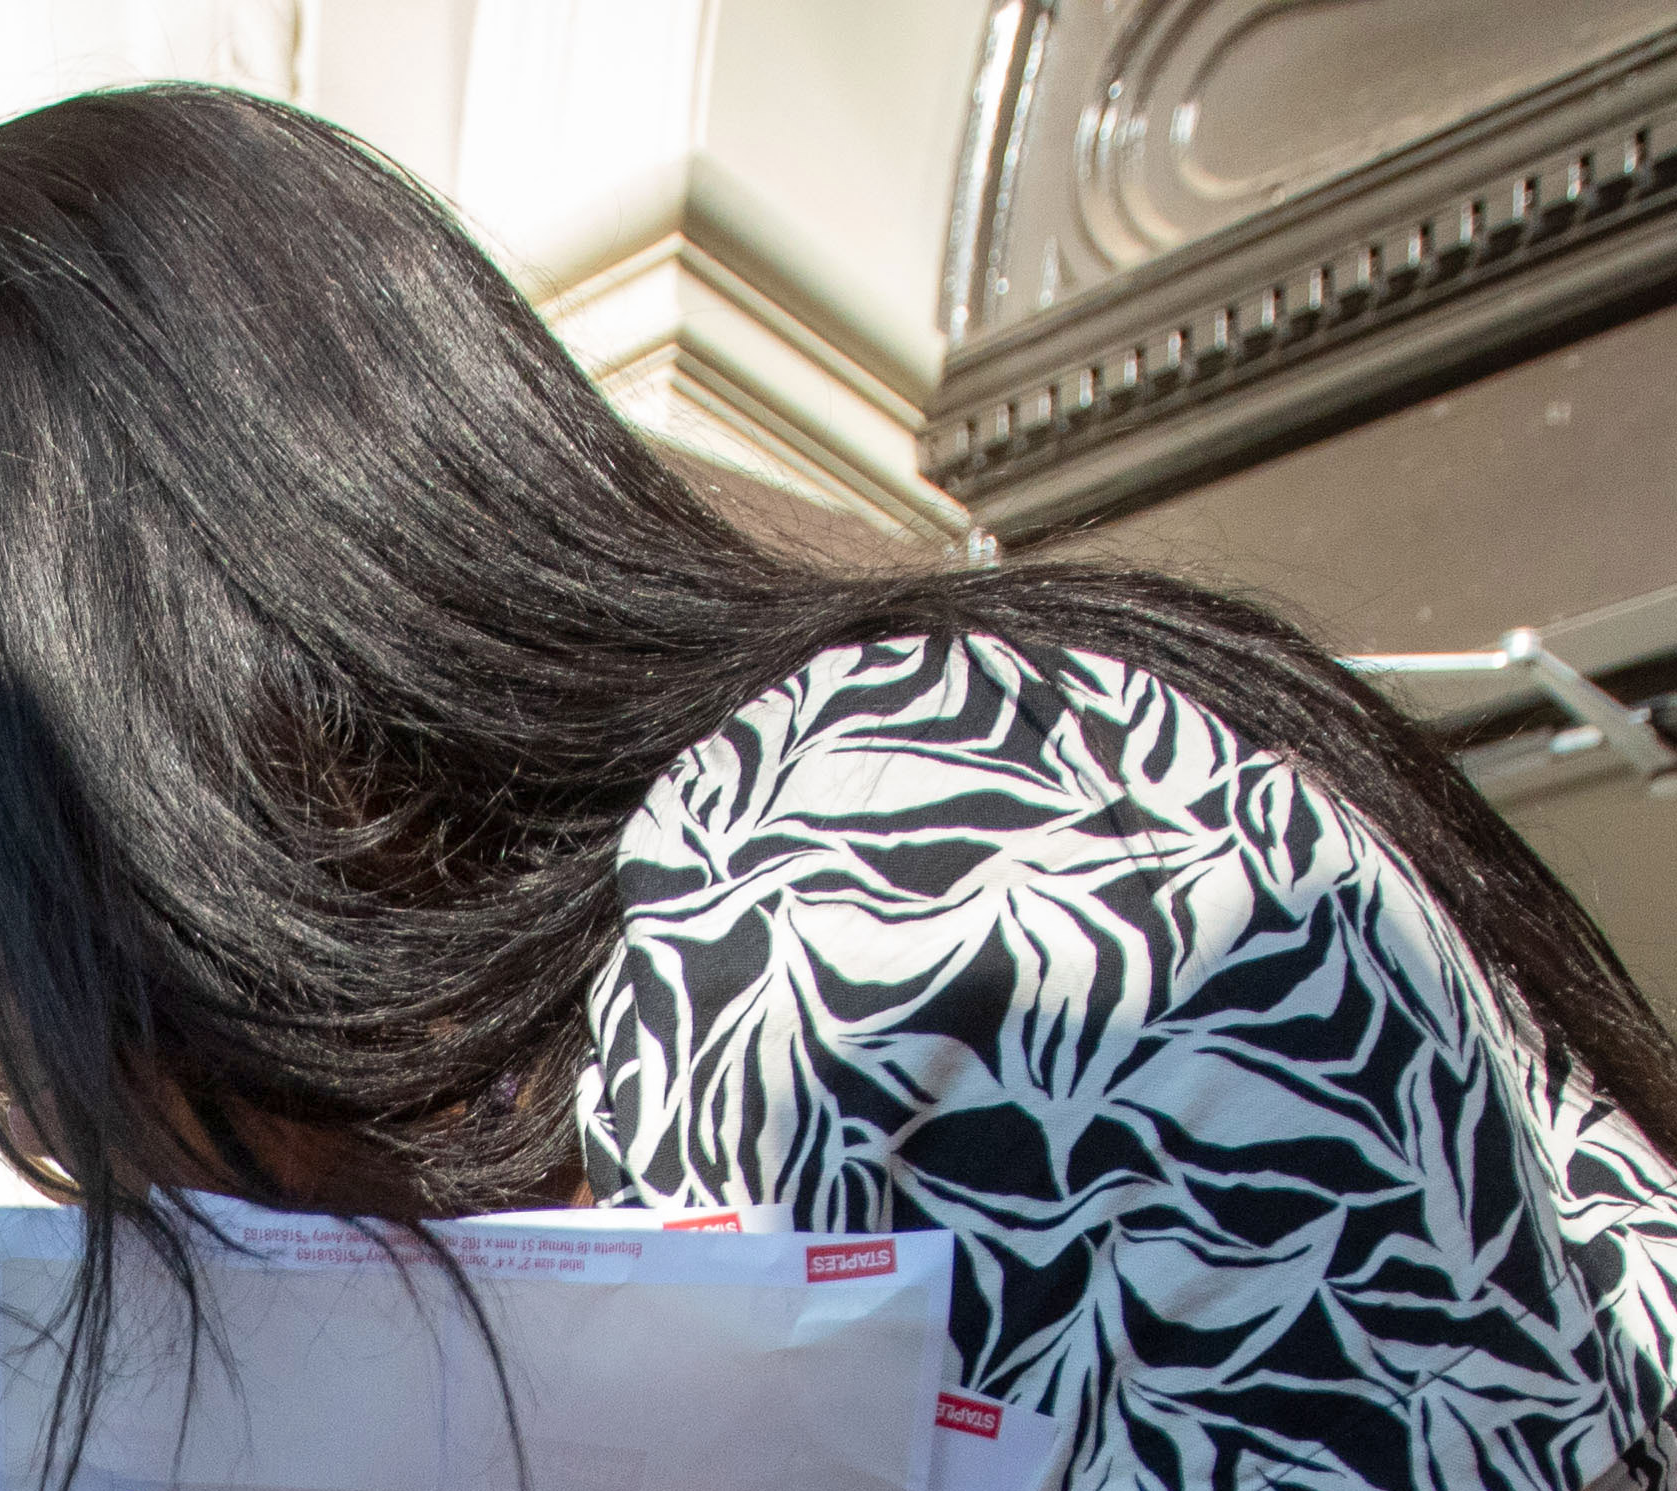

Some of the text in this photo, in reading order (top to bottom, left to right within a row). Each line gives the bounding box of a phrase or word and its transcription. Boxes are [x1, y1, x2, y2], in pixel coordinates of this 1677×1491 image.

[558, 1258, 584, 1272] label
[812, 1249, 890, 1273] STAPLES
[936, 1402, 996, 1429] STAPLE
